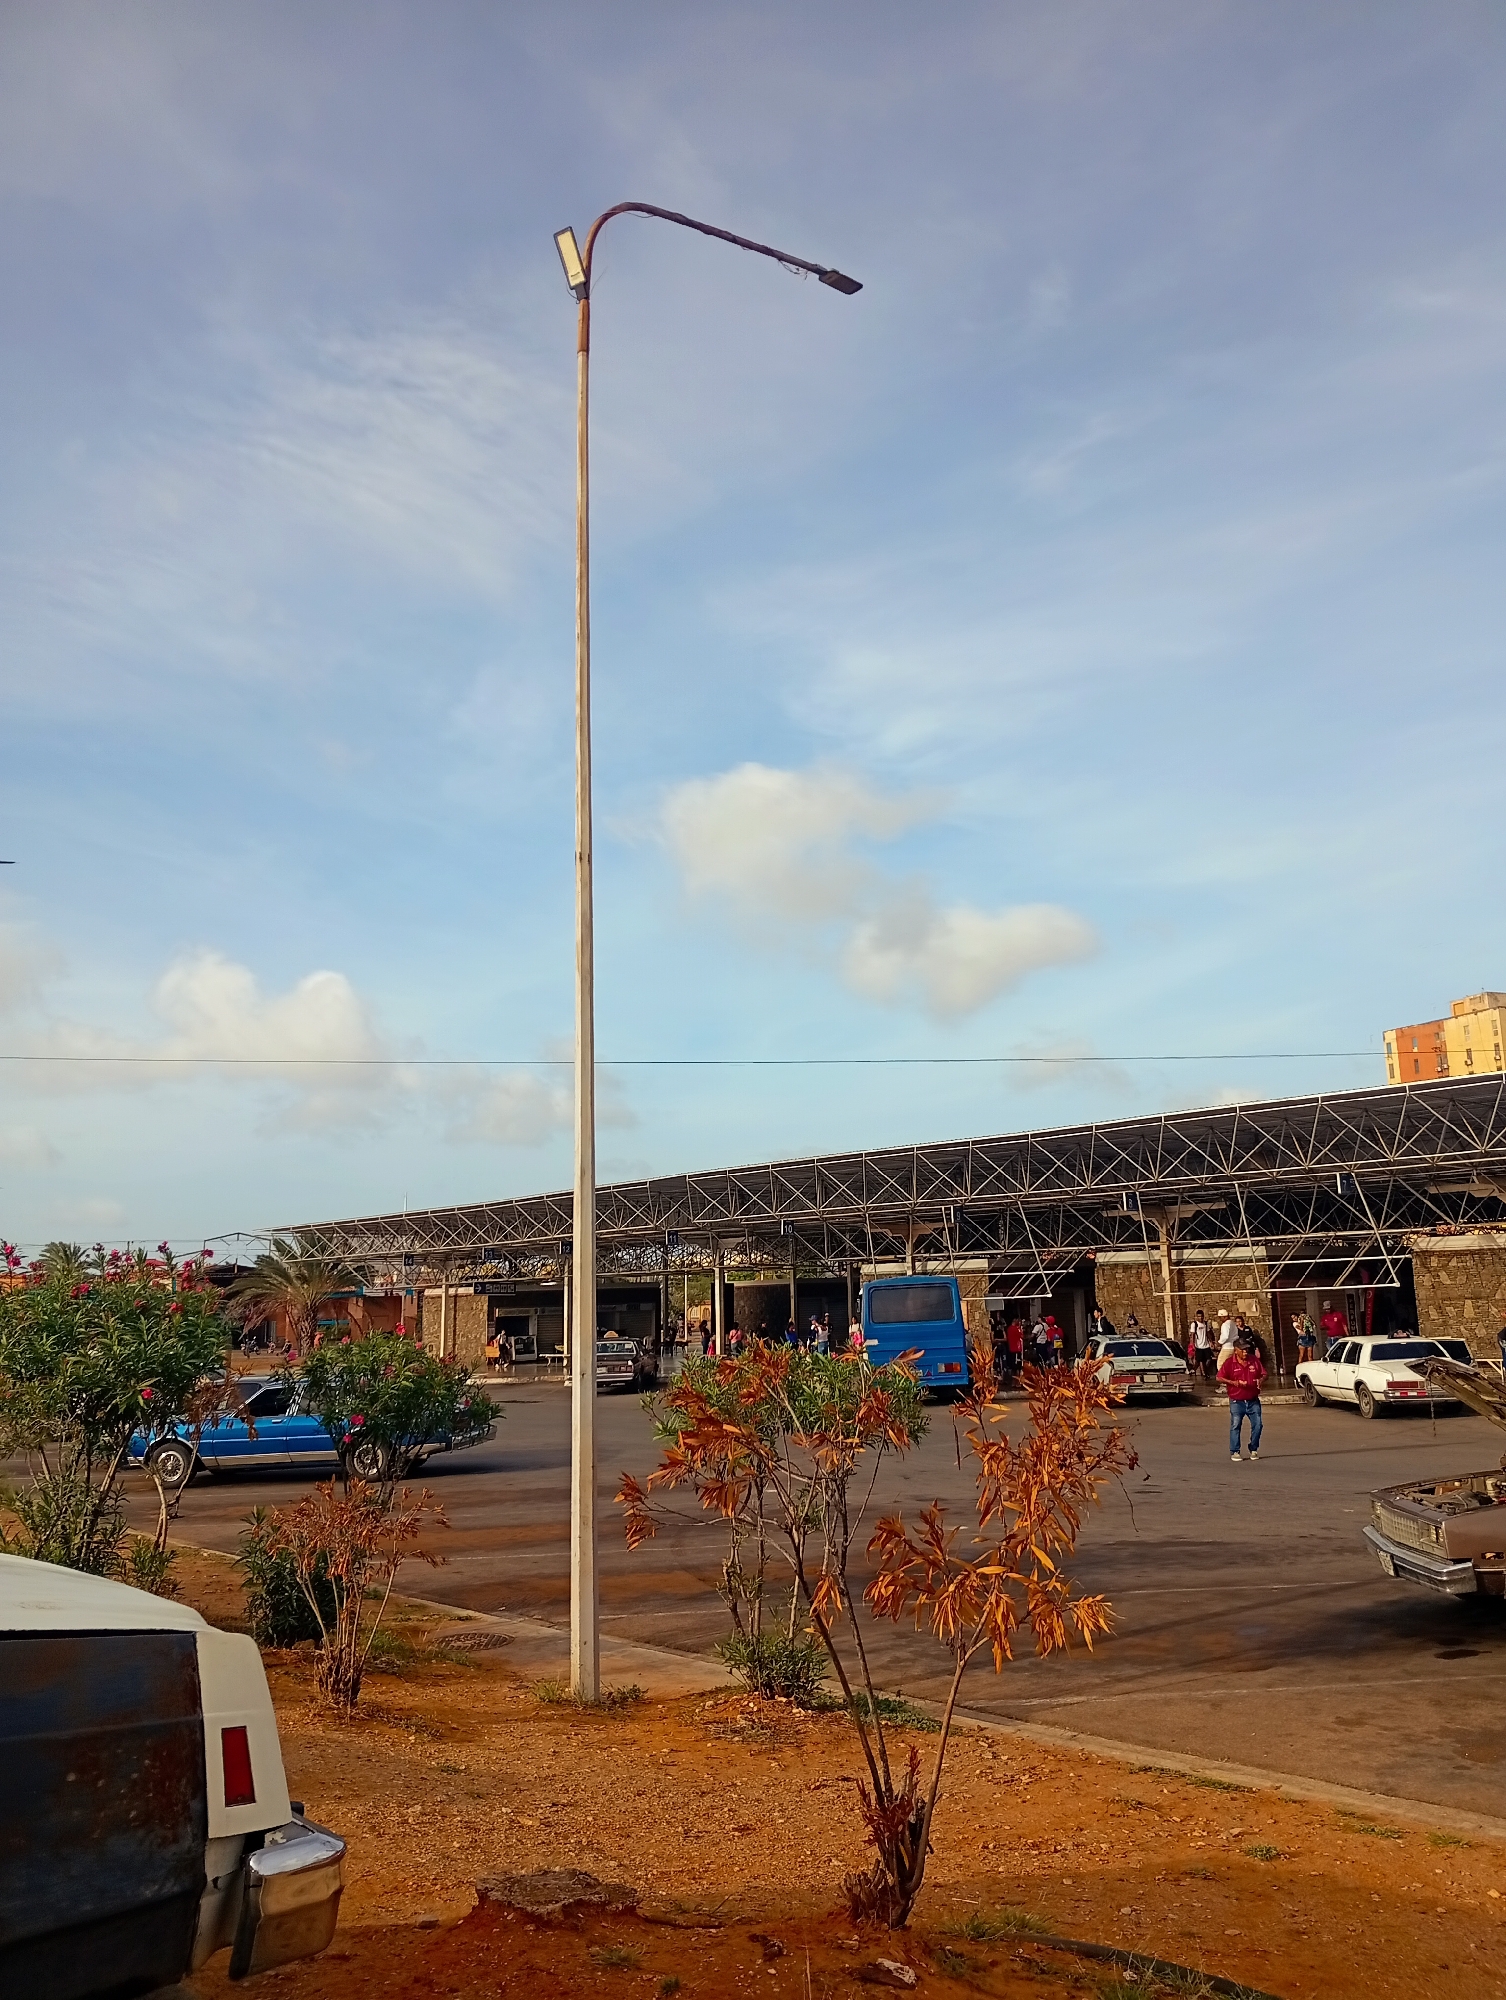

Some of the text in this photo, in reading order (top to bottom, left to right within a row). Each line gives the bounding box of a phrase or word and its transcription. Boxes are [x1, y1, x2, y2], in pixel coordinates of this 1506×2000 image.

[956, 1212, 961, 1221] 9
[784, 1224, 793, 1233] 10
[669, 1235, 677, 1243] 11
[405, 1257, 413, 1265] 14
